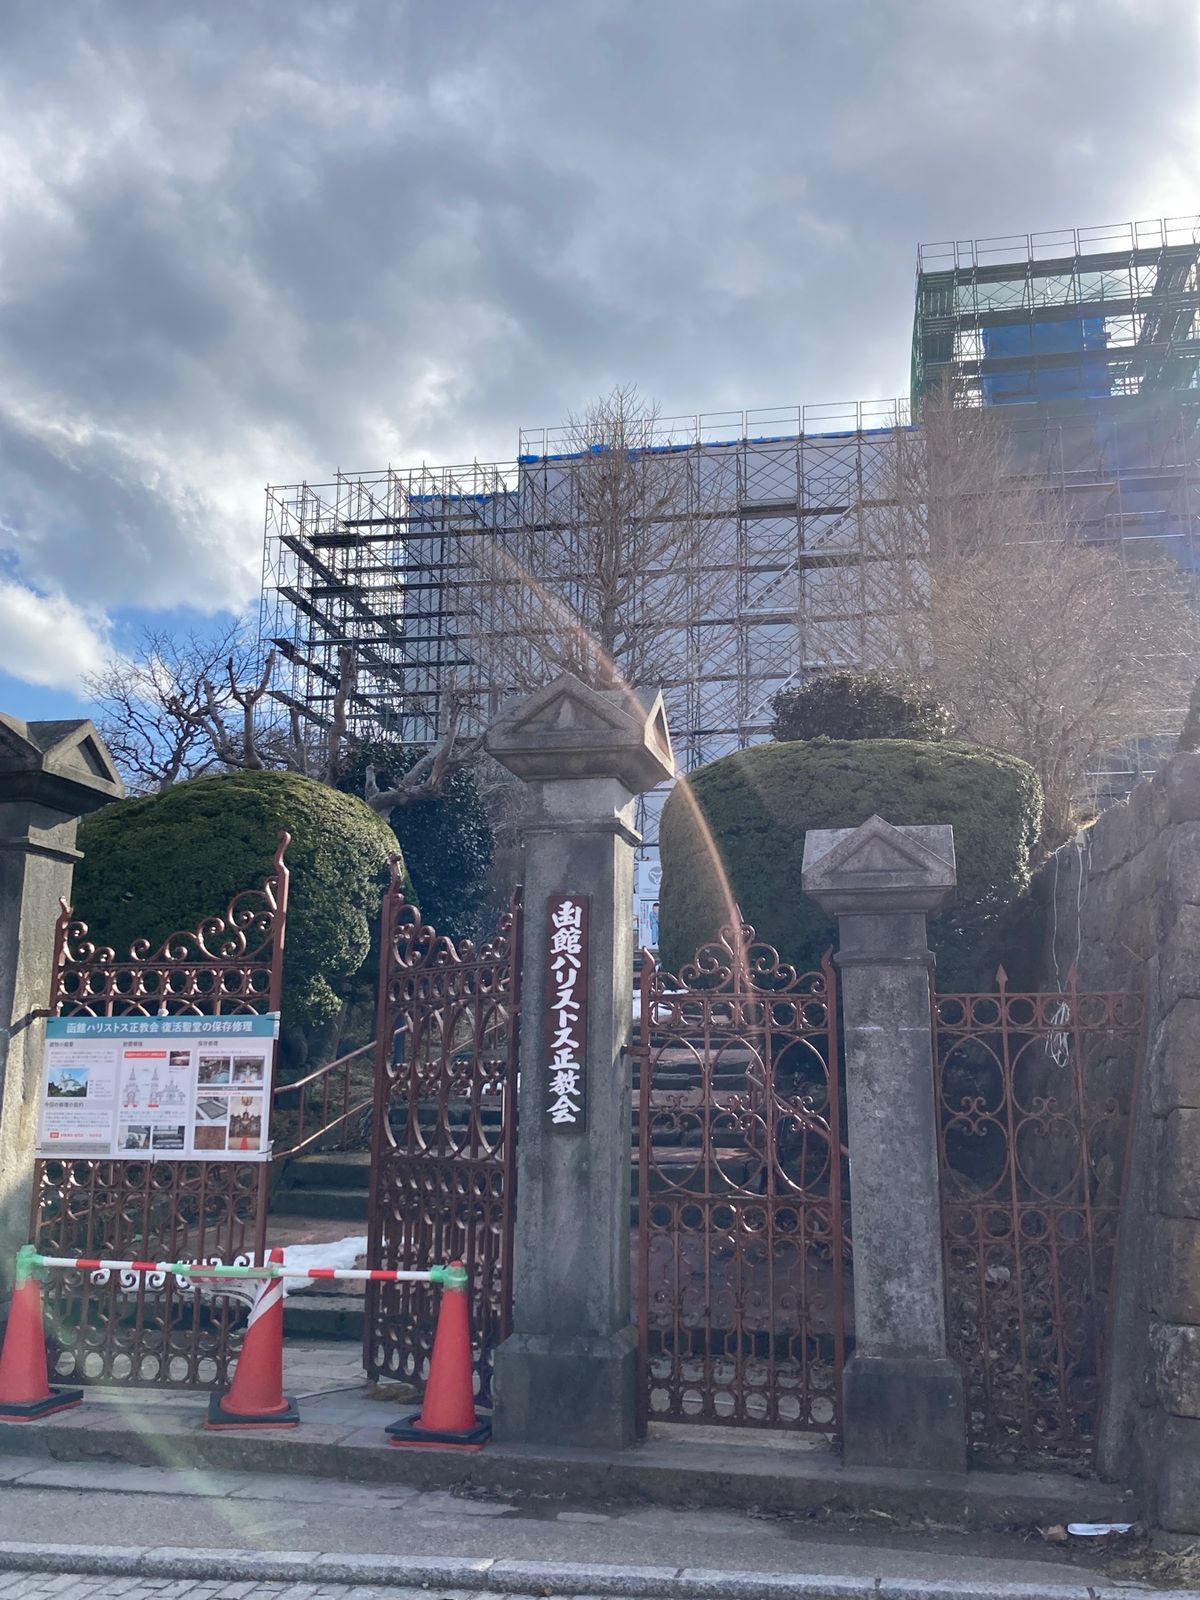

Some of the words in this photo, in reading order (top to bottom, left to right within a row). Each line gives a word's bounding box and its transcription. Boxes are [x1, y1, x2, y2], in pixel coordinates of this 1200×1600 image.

[66, 1022, 159, 1034] 函館ハリストス正教会
[161, 1020, 253, 1033] 復活聖堂の保存修理
[547, 901, 583, 1123] 函館ハリストス正教会
